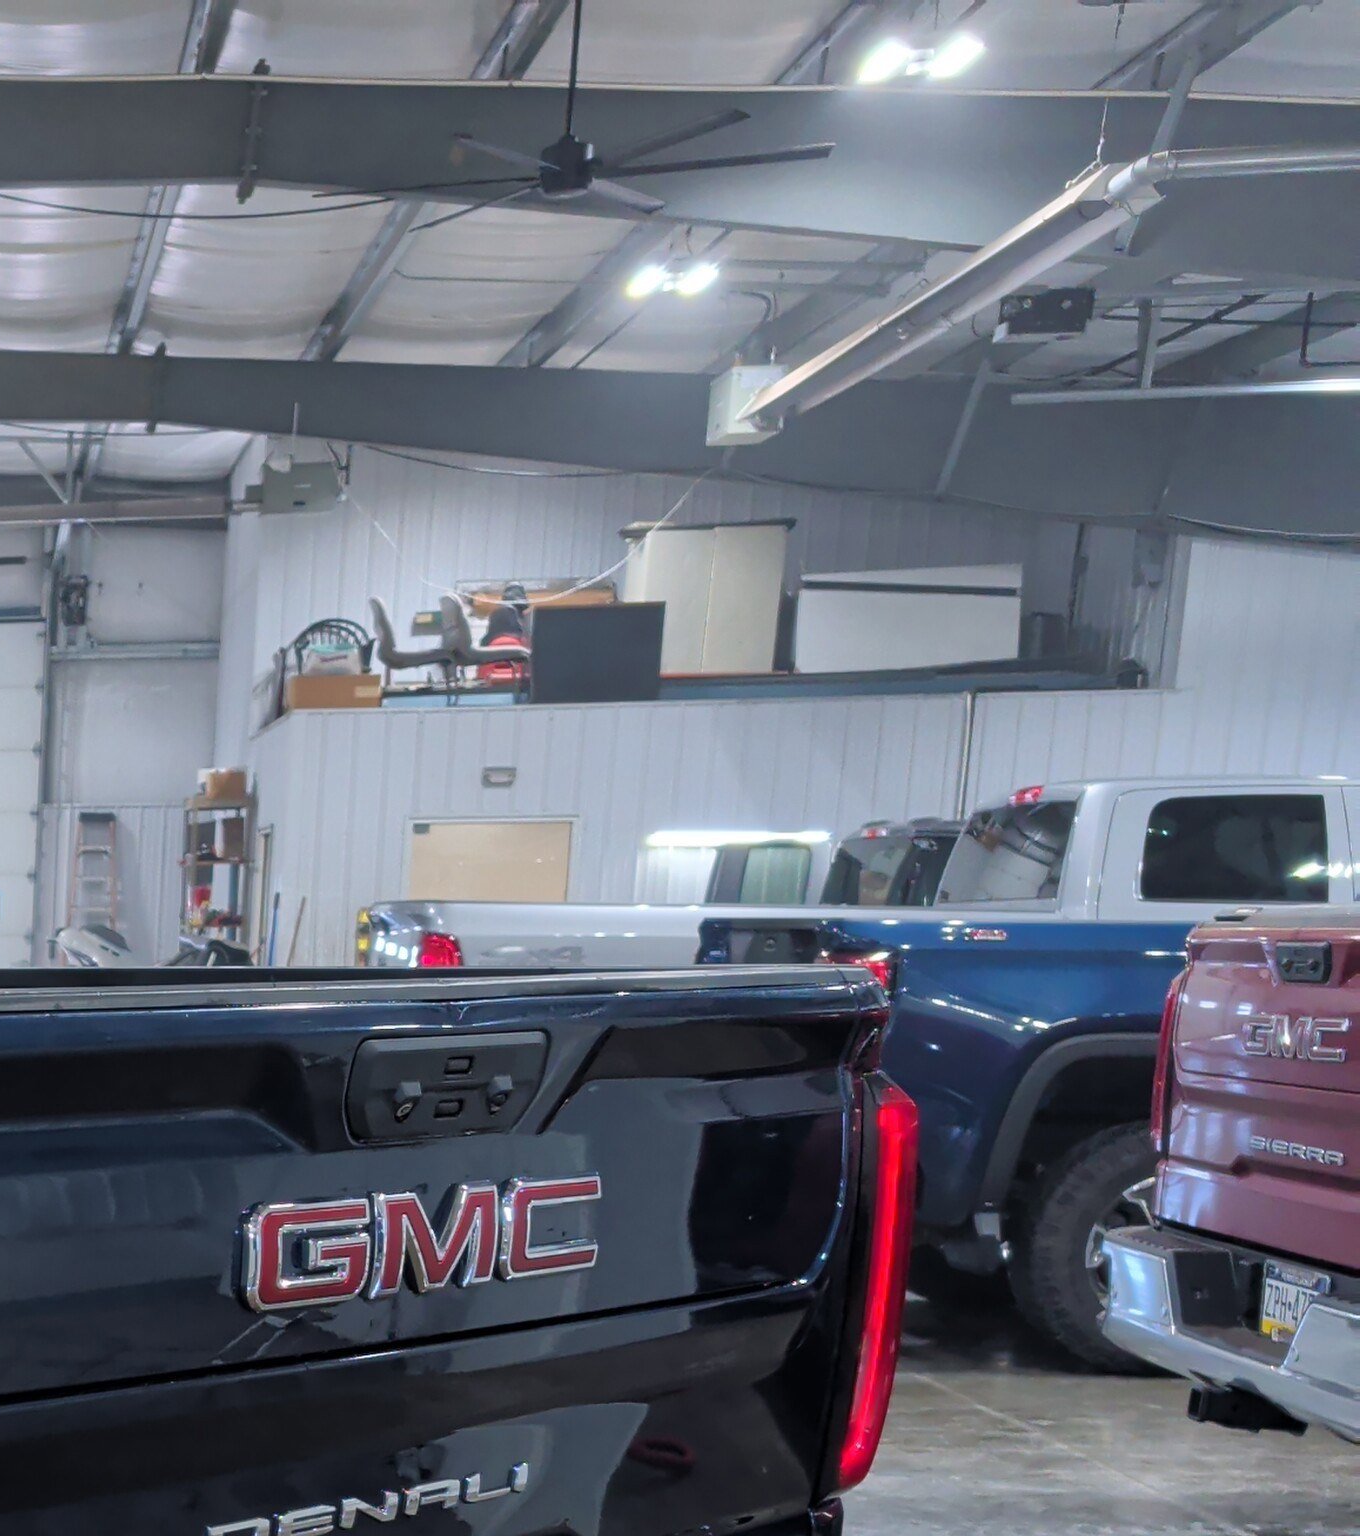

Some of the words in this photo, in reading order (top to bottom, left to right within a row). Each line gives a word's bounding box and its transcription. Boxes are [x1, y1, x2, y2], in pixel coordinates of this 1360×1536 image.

[1242, 1014, 1350, 1063] GMC
[1249, 1135, 1346, 1167] SIERRA
[242, 1173, 602, 1312] GMC
